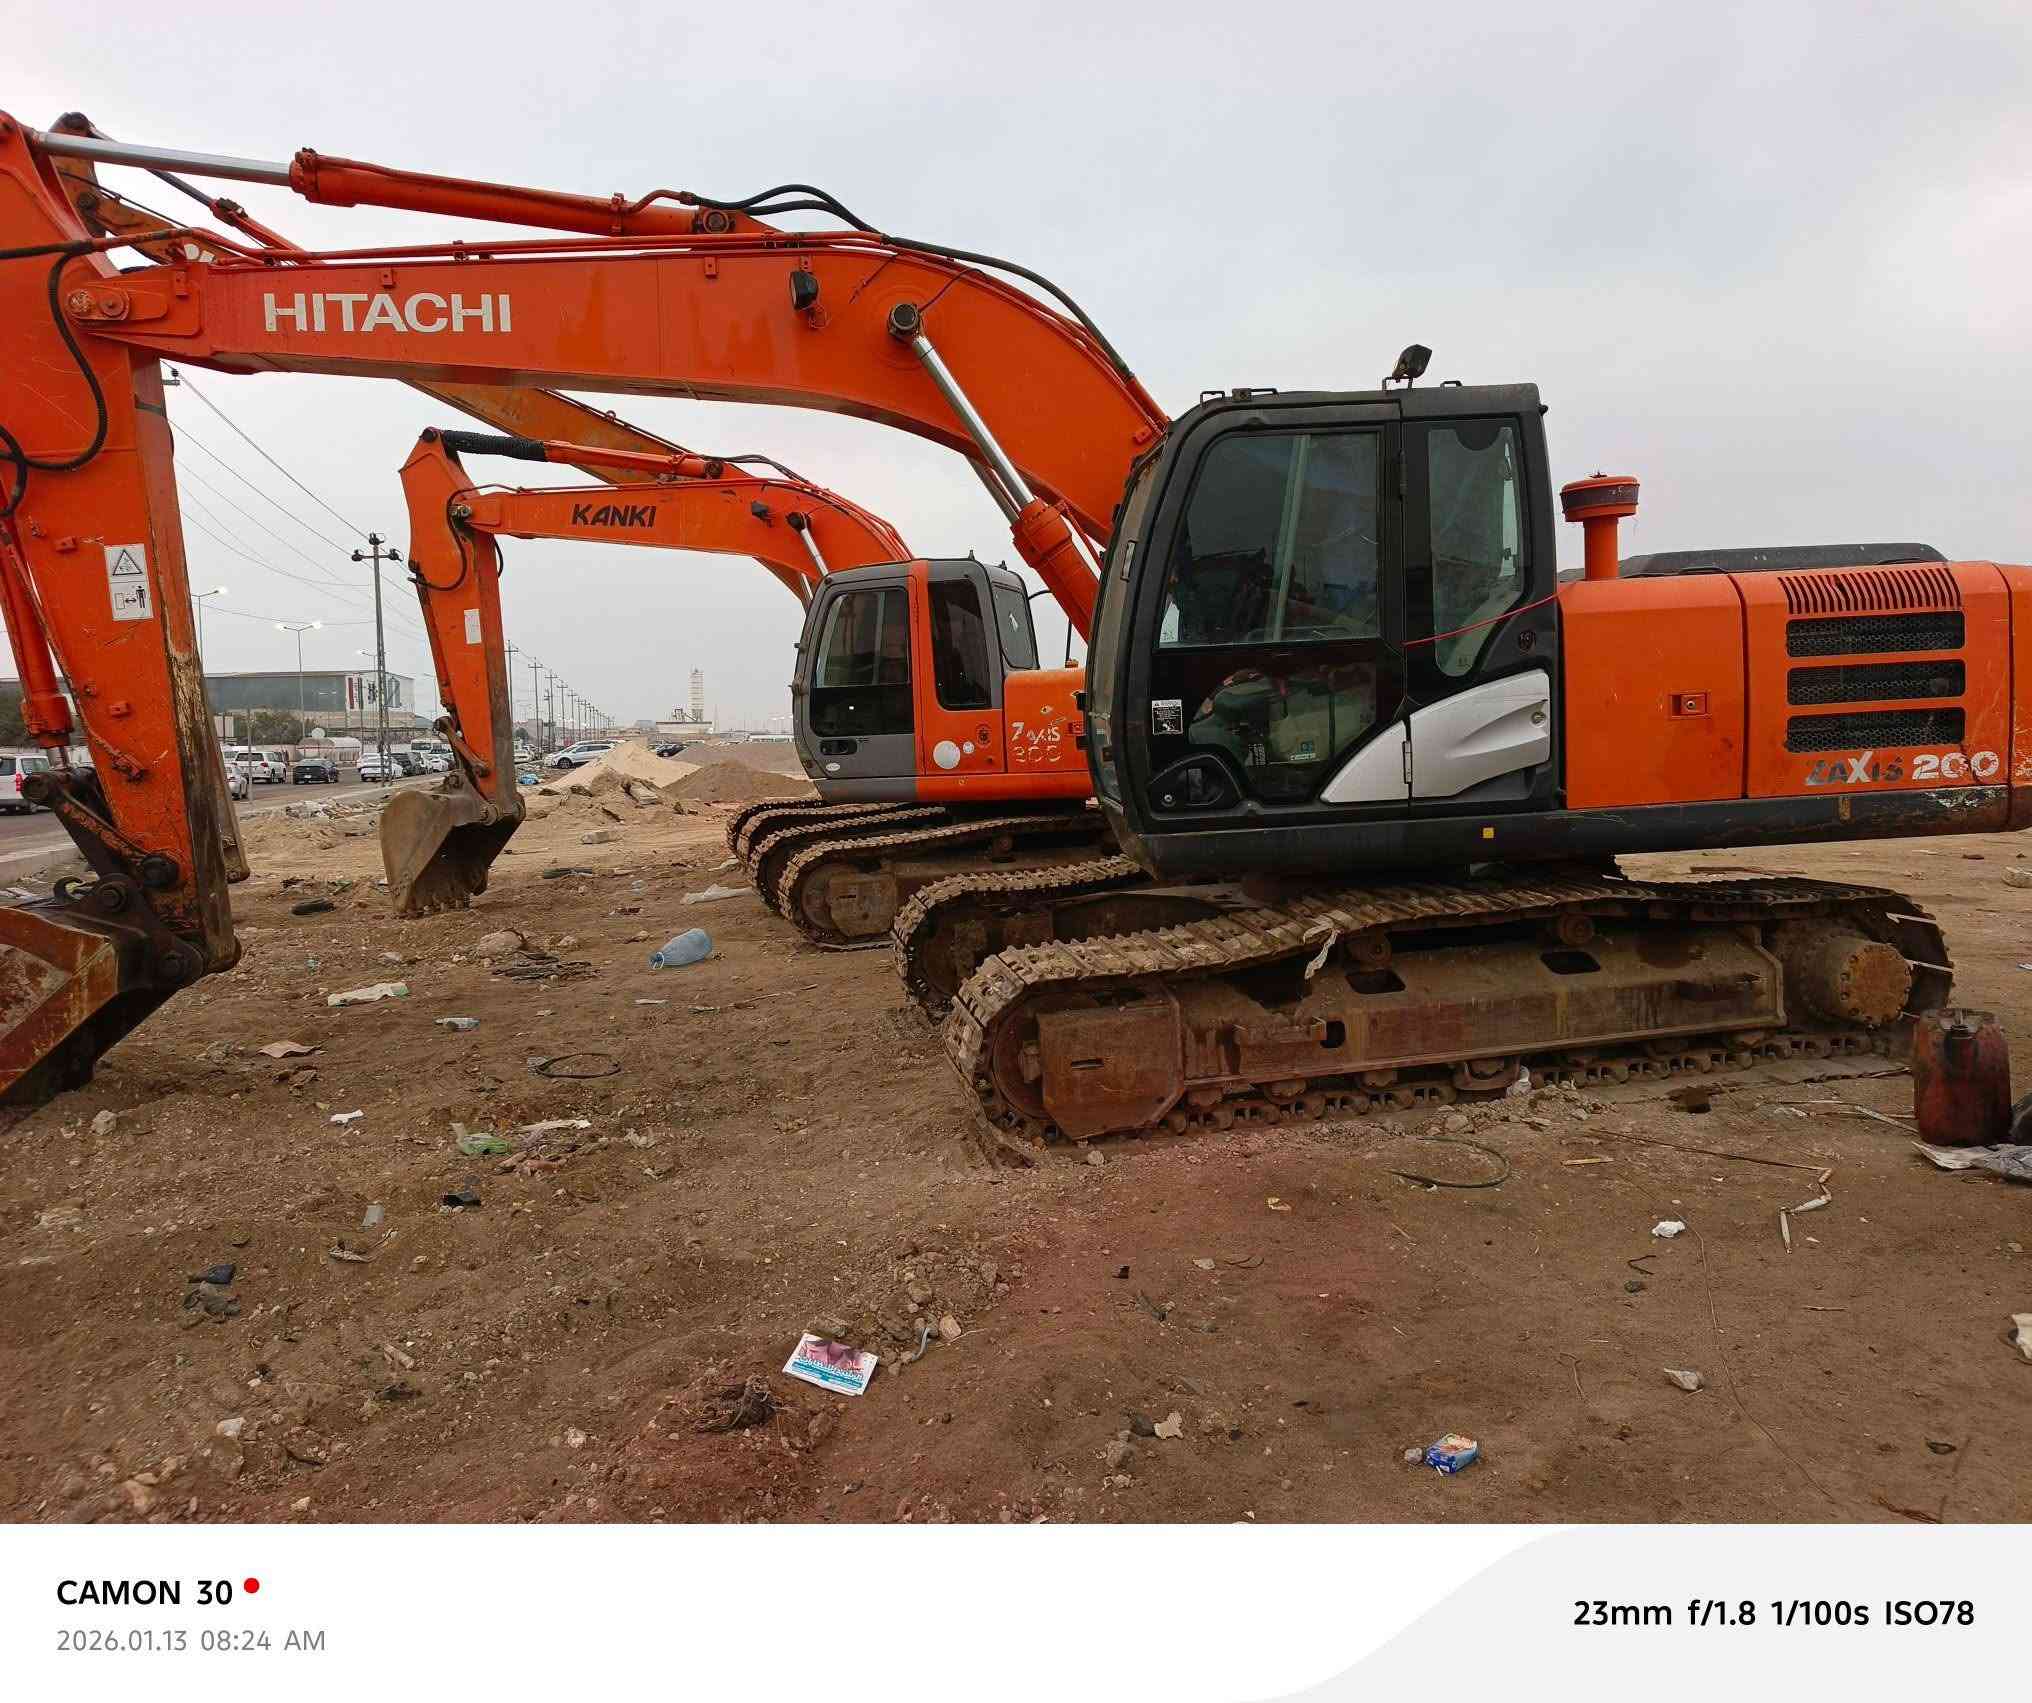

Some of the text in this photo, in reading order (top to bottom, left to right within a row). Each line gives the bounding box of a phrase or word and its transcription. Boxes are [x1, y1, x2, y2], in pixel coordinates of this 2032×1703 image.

[263, 292, 512, 333] HITACHI
[571, 503, 657, 528] KANKI
[1911, 751, 2000, 782] 200
